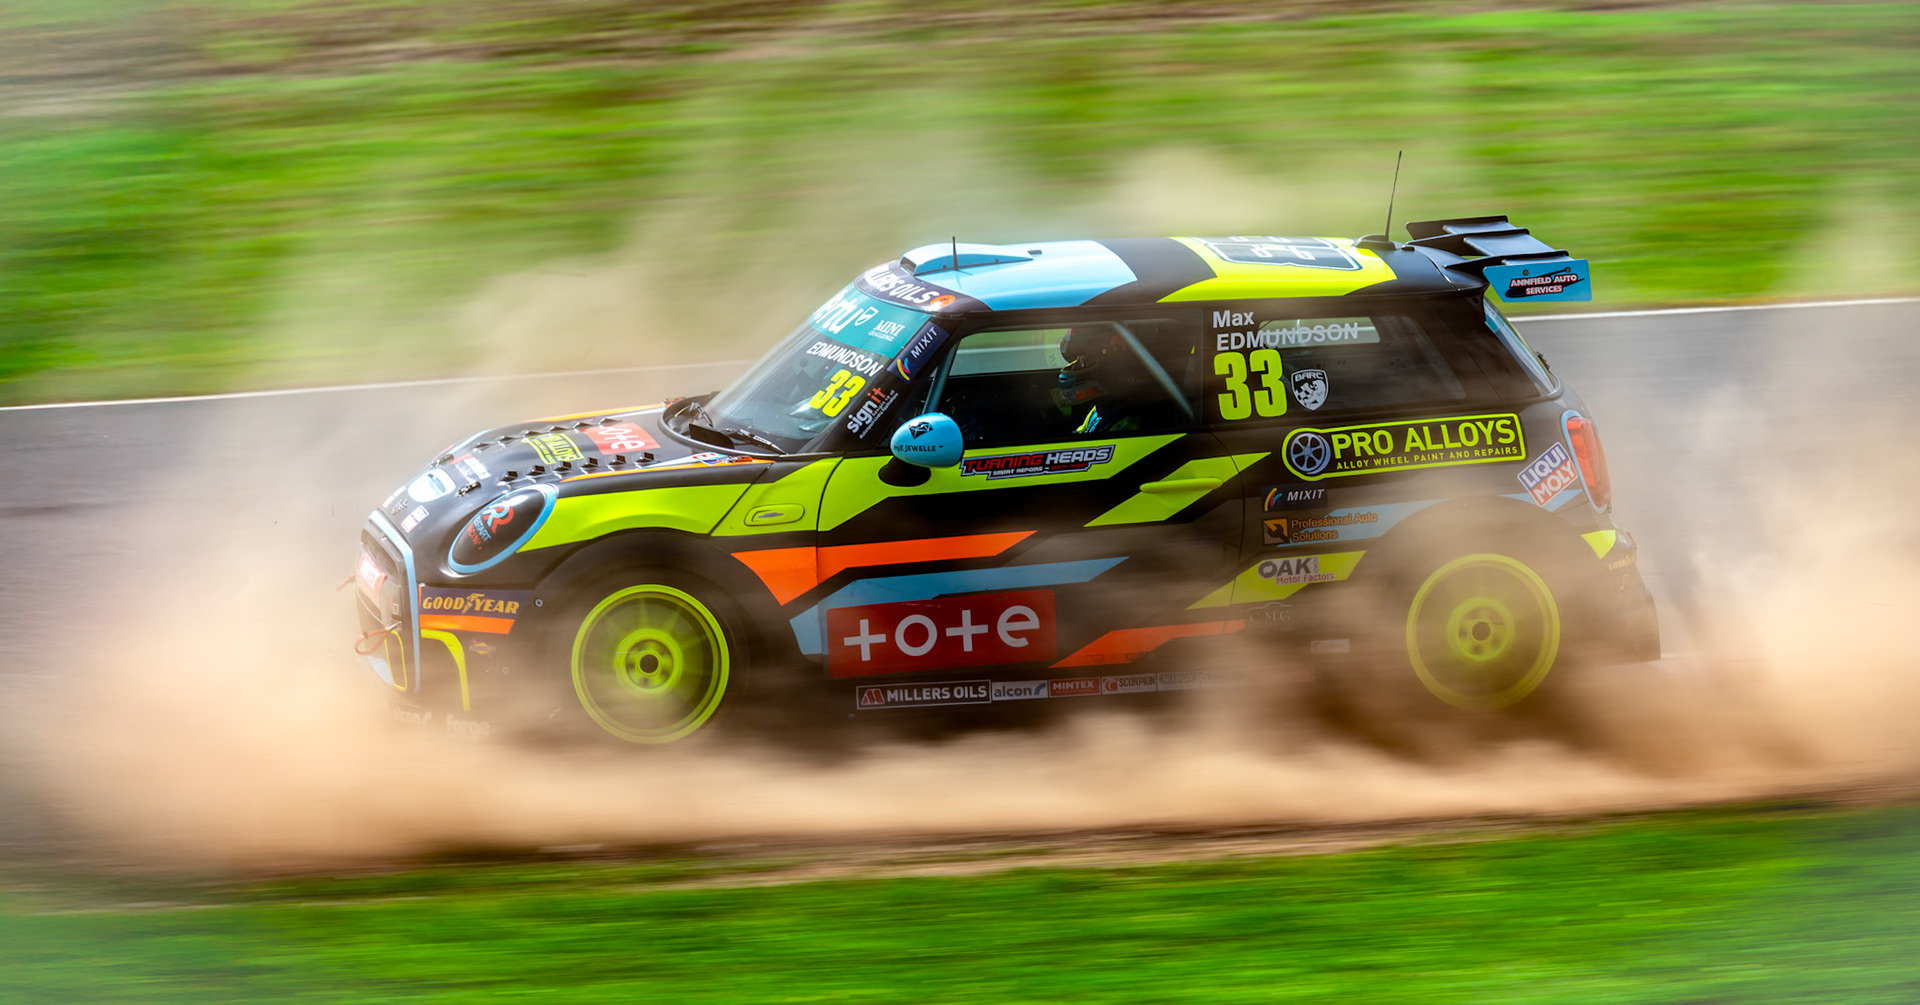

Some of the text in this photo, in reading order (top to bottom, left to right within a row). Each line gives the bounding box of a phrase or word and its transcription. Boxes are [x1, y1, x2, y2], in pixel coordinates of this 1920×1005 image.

[1510, 274, 1578, 288] ANNFIELD AUTO
[1525, 285, 1563, 295] SERVICES
[889, 281, 940, 304] OILS
[873, 319, 905, 337] MINI
[1212, 310, 1255, 329] Max
[911, 326, 938, 359] MIXIT
[1216, 322, 1359, 351] EDMUNDSON
[806, 341, 884, 378] EDMUNDSON
[1213, 348, 1288, 421] 33
[1294, 371, 1324, 382] BARC
[808, 369, 867, 418] 33
[1331, 419, 1516, 459] PRO ALLOYS
[965, 448, 1110, 472] TURNING HEADS
[1336, 446, 1518, 470] ALLOY WHEEL PAINT AND REPAIRS
[1521, 446, 1567, 489] LIQUI
[1533, 460, 1575, 503] MOLY
[1286, 489, 1325, 501] MIXIT
[1291, 511, 1379, 530] Professional Auto
[1292, 529, 1339, 543] Solutions
[1257, 557, 1312, 579] OAK
[1276, 571, 1335, 585] Motor Factors
[843, 605, 1041, 662] tote
[993, 684, 1033, 698] alcon
[1052, 680, 1095, 691] MINTEX
[1118, 675, 1156, 687] SCORPION
[886, 685, 988, 702] MILLERS OILS
